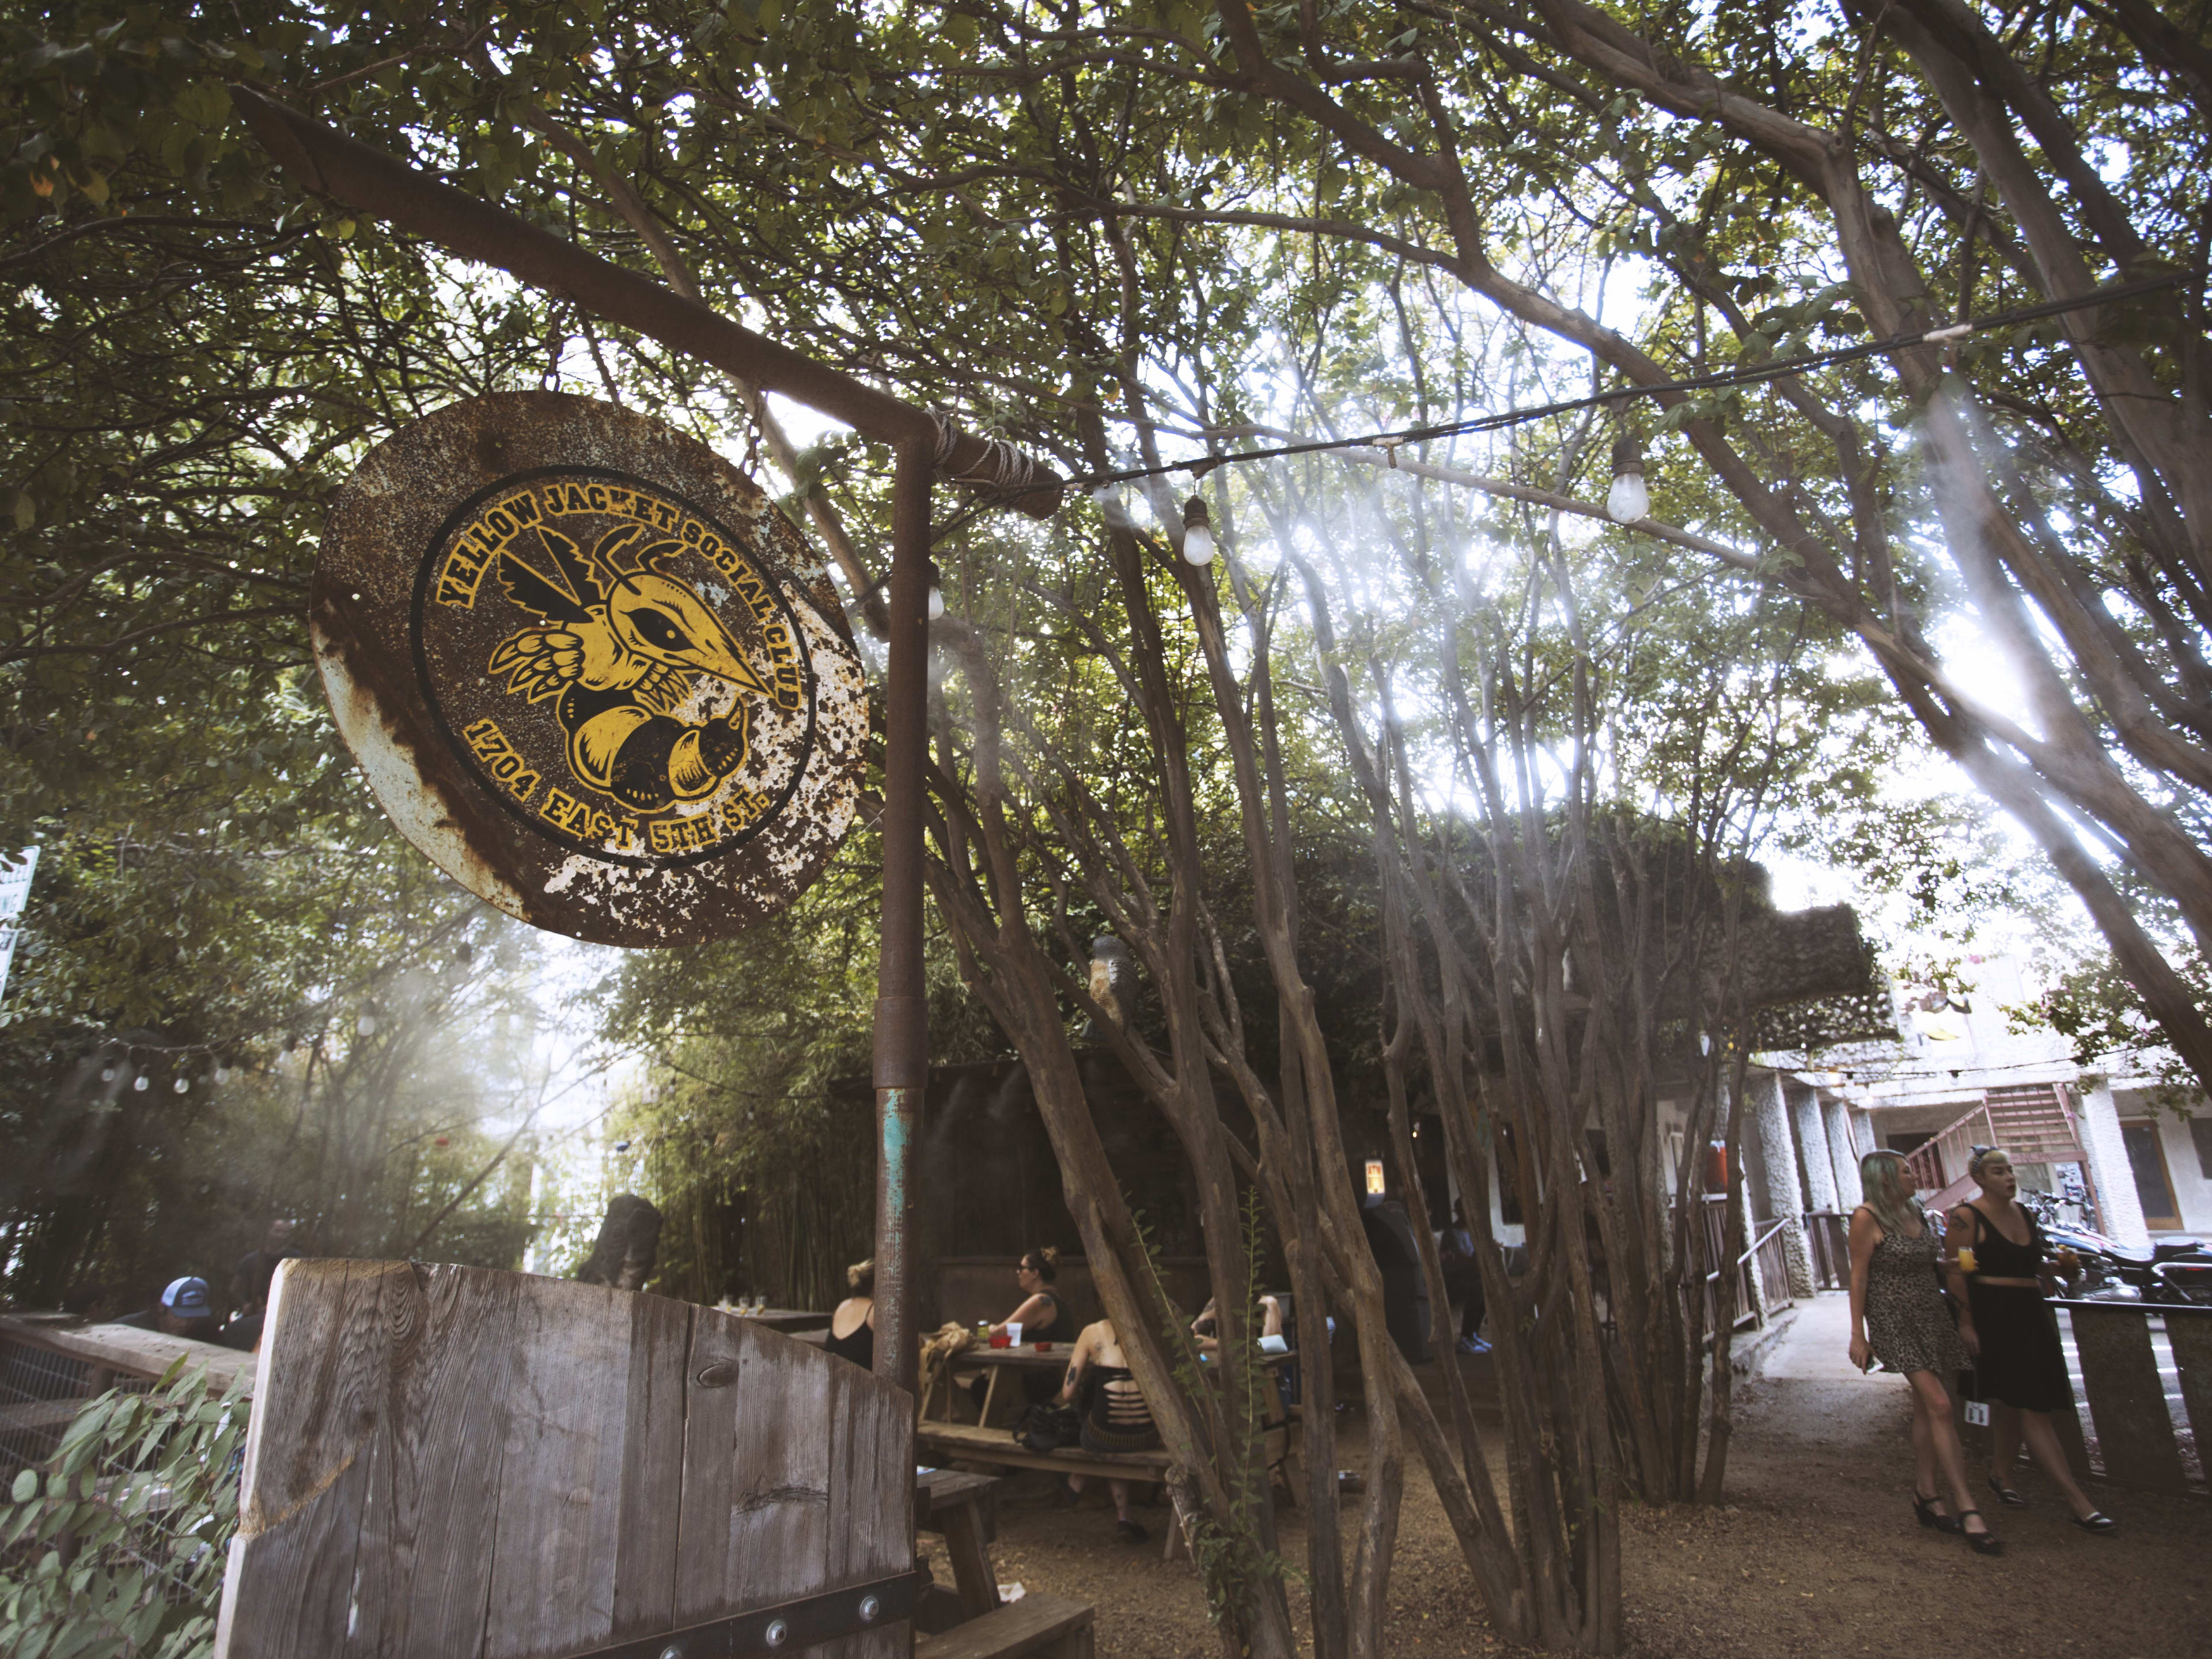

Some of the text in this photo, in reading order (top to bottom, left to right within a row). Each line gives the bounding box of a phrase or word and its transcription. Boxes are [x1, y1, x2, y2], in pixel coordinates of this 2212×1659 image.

[436, 483, 802, 711] YELLOW JACKET SOCIAL CLUB
[463, 719, 770, 853] 1704 EAST 5TH ST.
